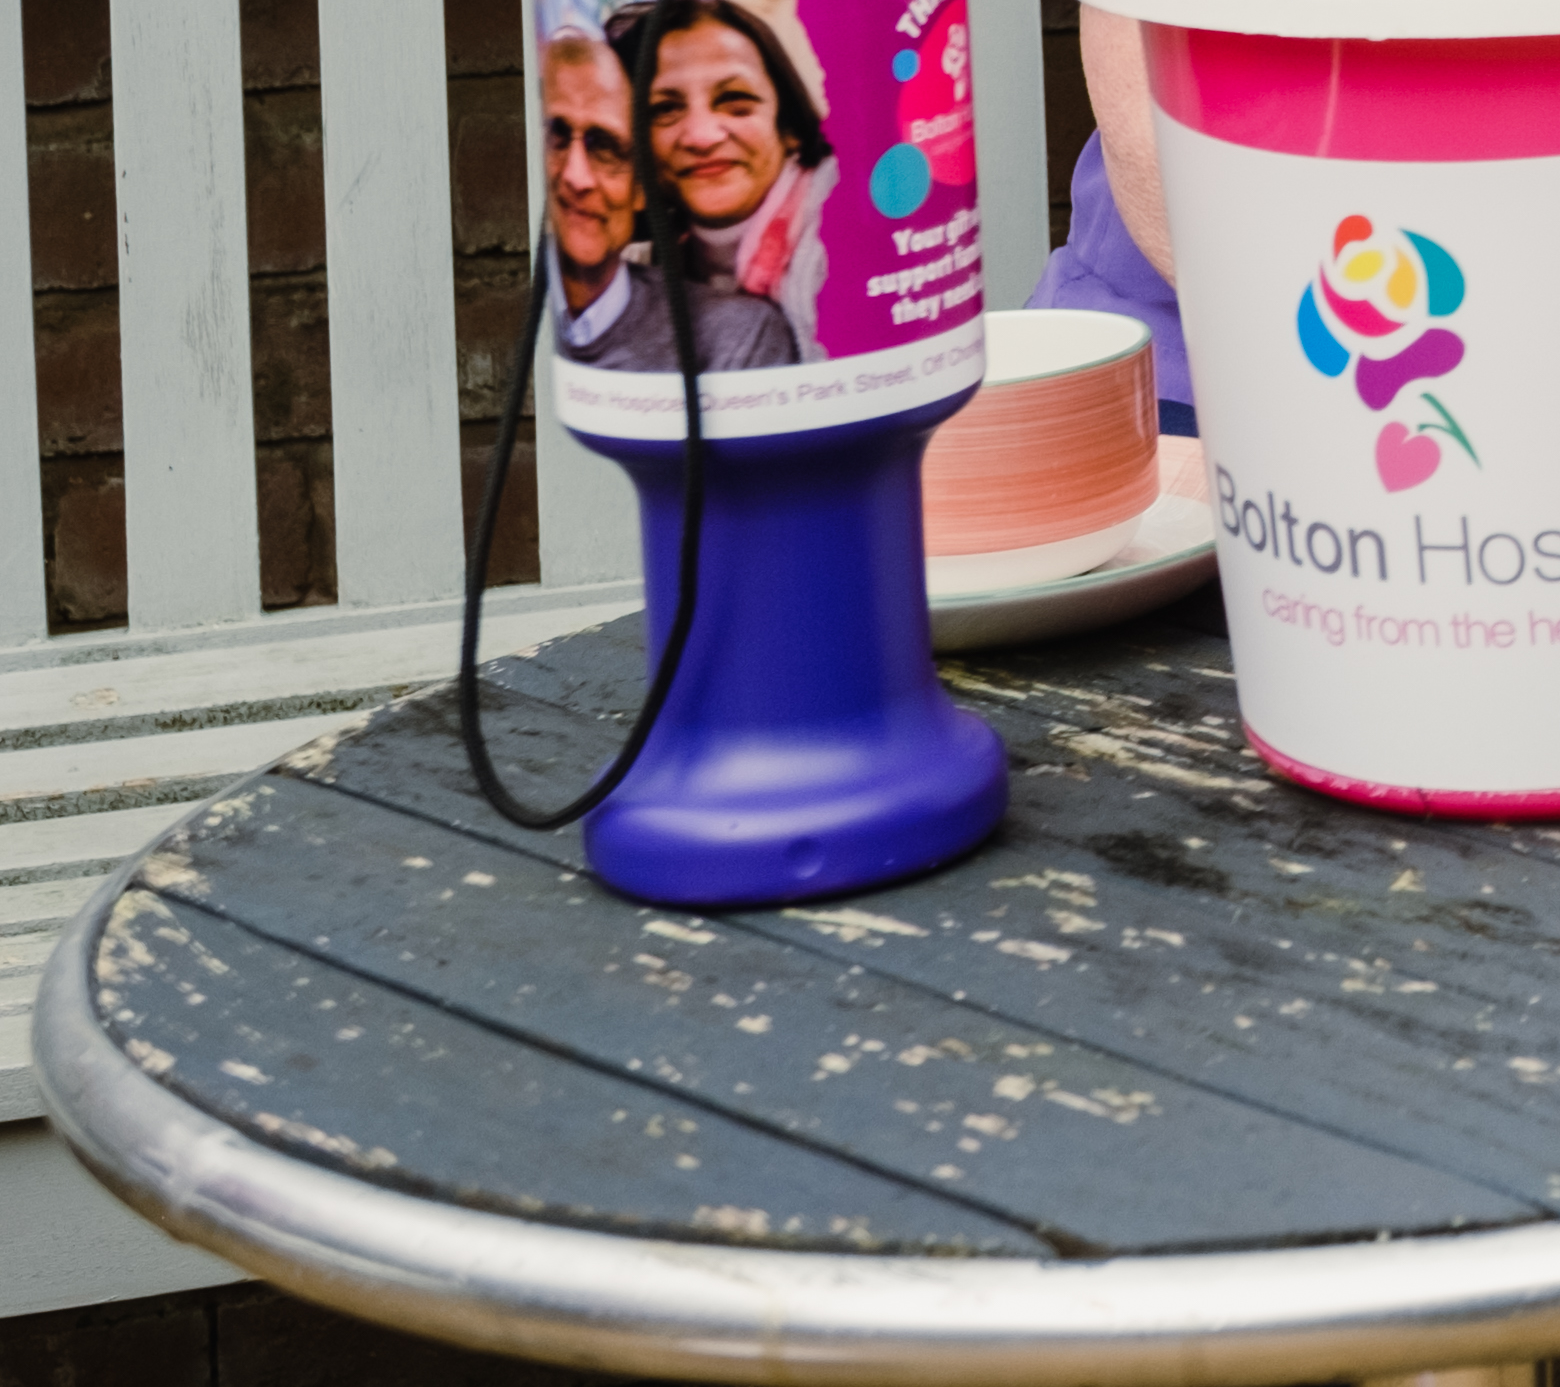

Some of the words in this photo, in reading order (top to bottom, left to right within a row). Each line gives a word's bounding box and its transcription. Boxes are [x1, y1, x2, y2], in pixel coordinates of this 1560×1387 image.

[796, 380, 850, 403] Park
[1214, 462, 1389, 583] Bolton
[1262, 588, 1346, 647] caring
[1352, 604, 1441, 648] from
[1451, 613, 1516, 649] the
